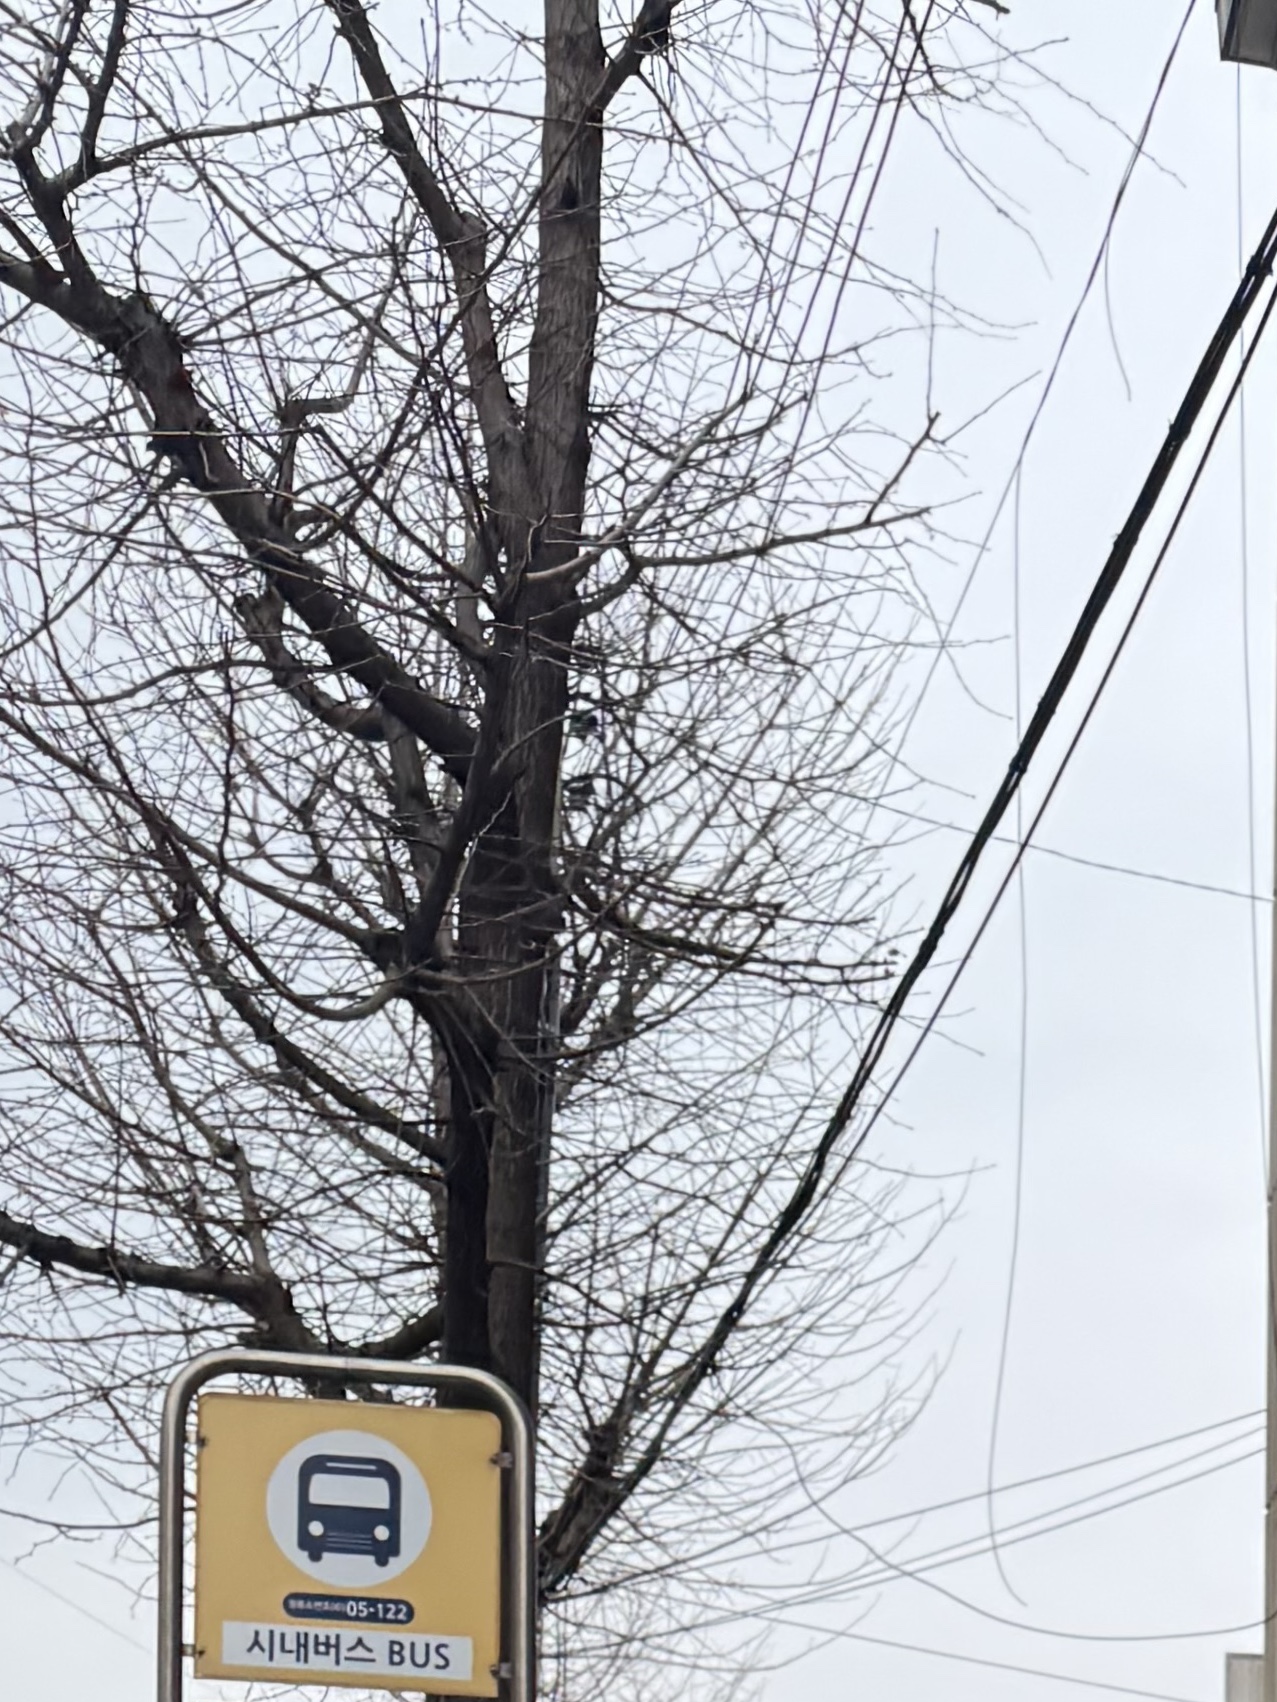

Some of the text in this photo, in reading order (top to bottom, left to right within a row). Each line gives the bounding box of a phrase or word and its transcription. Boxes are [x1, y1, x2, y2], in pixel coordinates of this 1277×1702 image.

[346, 1600, 408, 1621] 05-122
[246, 1628, 451, 1671] 시내버스 BUS
